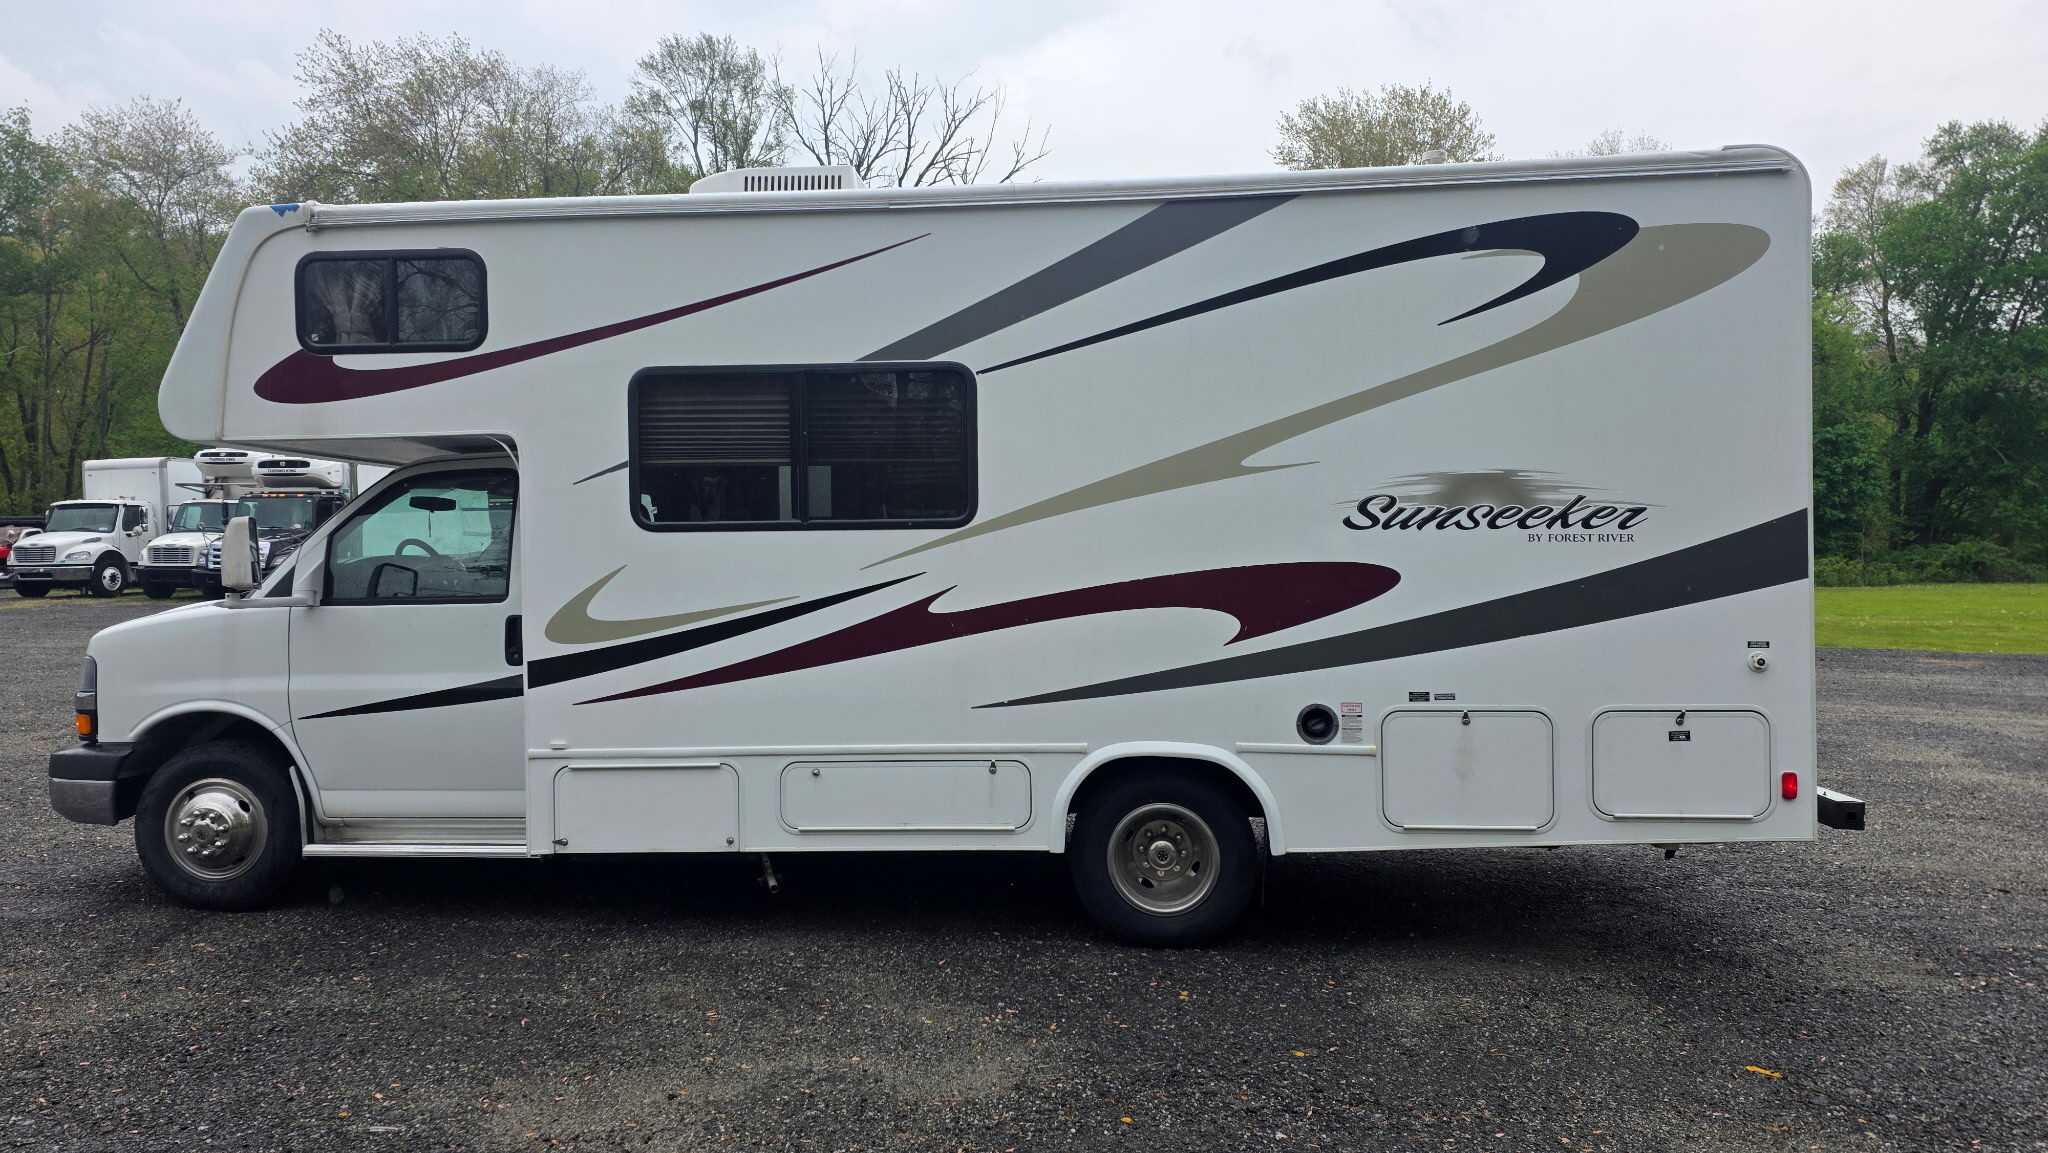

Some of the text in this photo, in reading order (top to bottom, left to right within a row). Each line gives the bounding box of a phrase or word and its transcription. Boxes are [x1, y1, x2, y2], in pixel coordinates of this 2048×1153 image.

[1342, 494, 1648, 531] Sunseeker
[1527, 533, 1635, 543] BY FOREST RIVER
